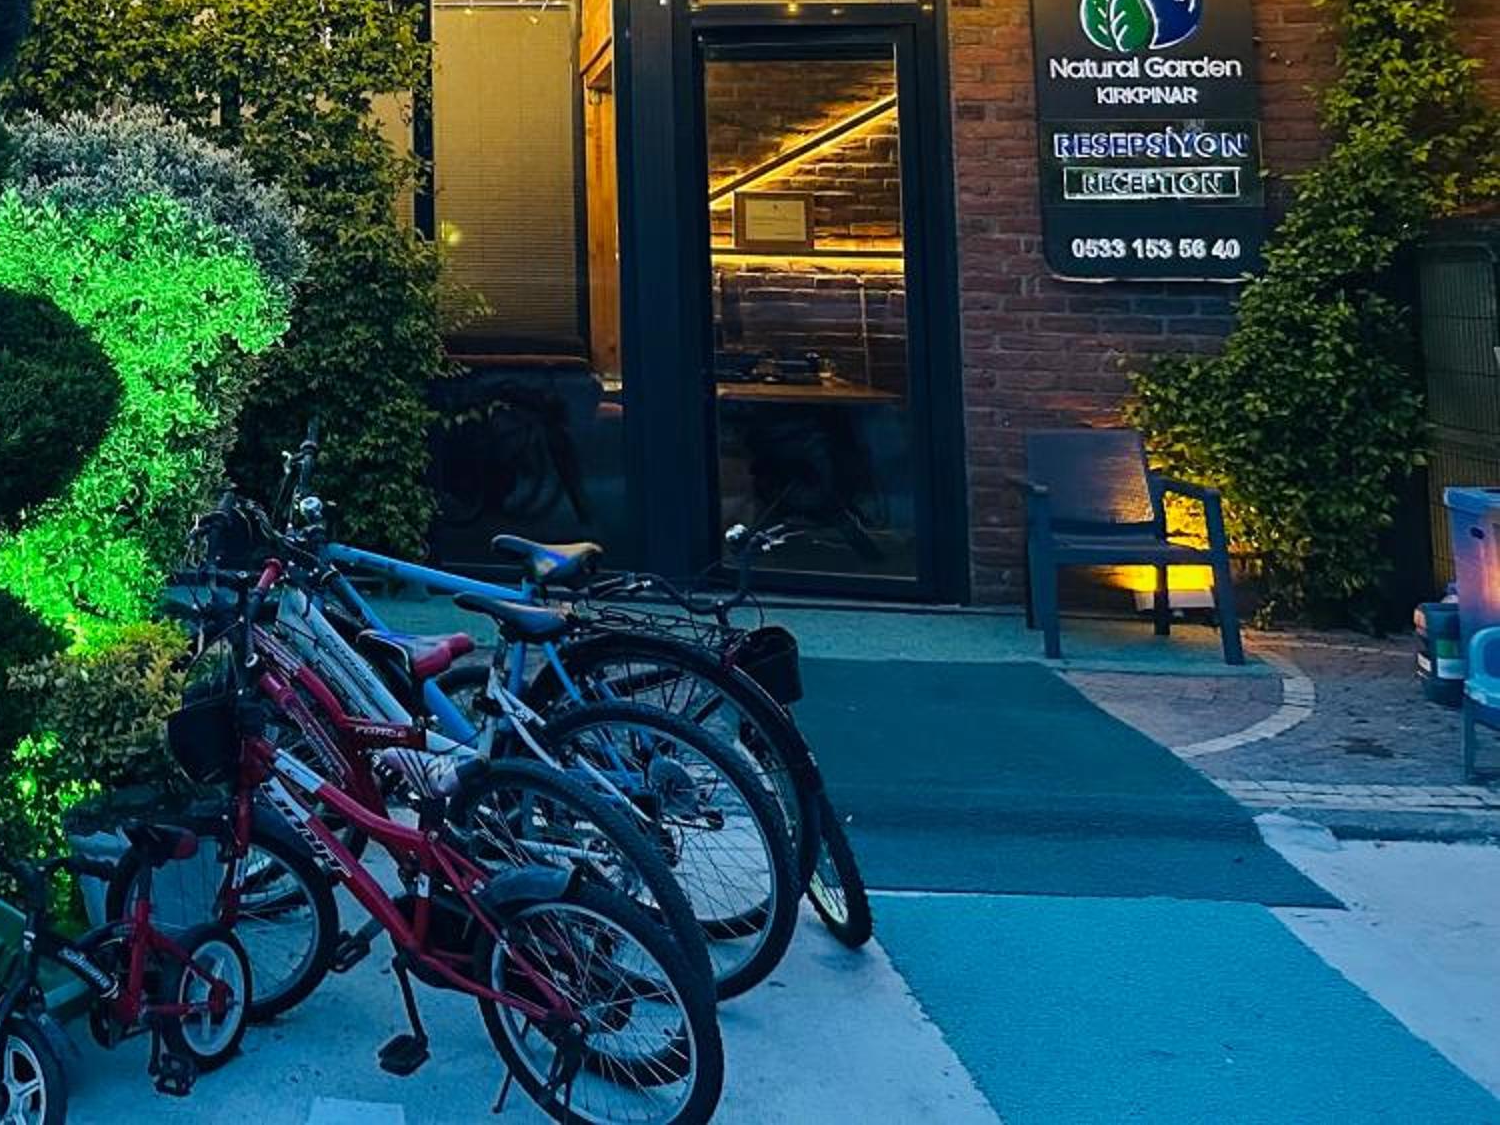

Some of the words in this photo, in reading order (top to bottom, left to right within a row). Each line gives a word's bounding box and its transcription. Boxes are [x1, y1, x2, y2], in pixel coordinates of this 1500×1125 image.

[1049, 57, 1140, 79] Natural
[1145, 56, 1243, 78] Garden
[1097, 86, 1199, 104] KIRKPINAR
[1053, 125, 1249, 158] RESEPSİYON
[1082, 172, 1223, 194] RECEPTION
[1071, 238, 1126, 258] 0533
[1132, 238, 1173, 259] 153
[1179, 238, 1207, 258] 56
[1211, 238, 1241, 259] 40
